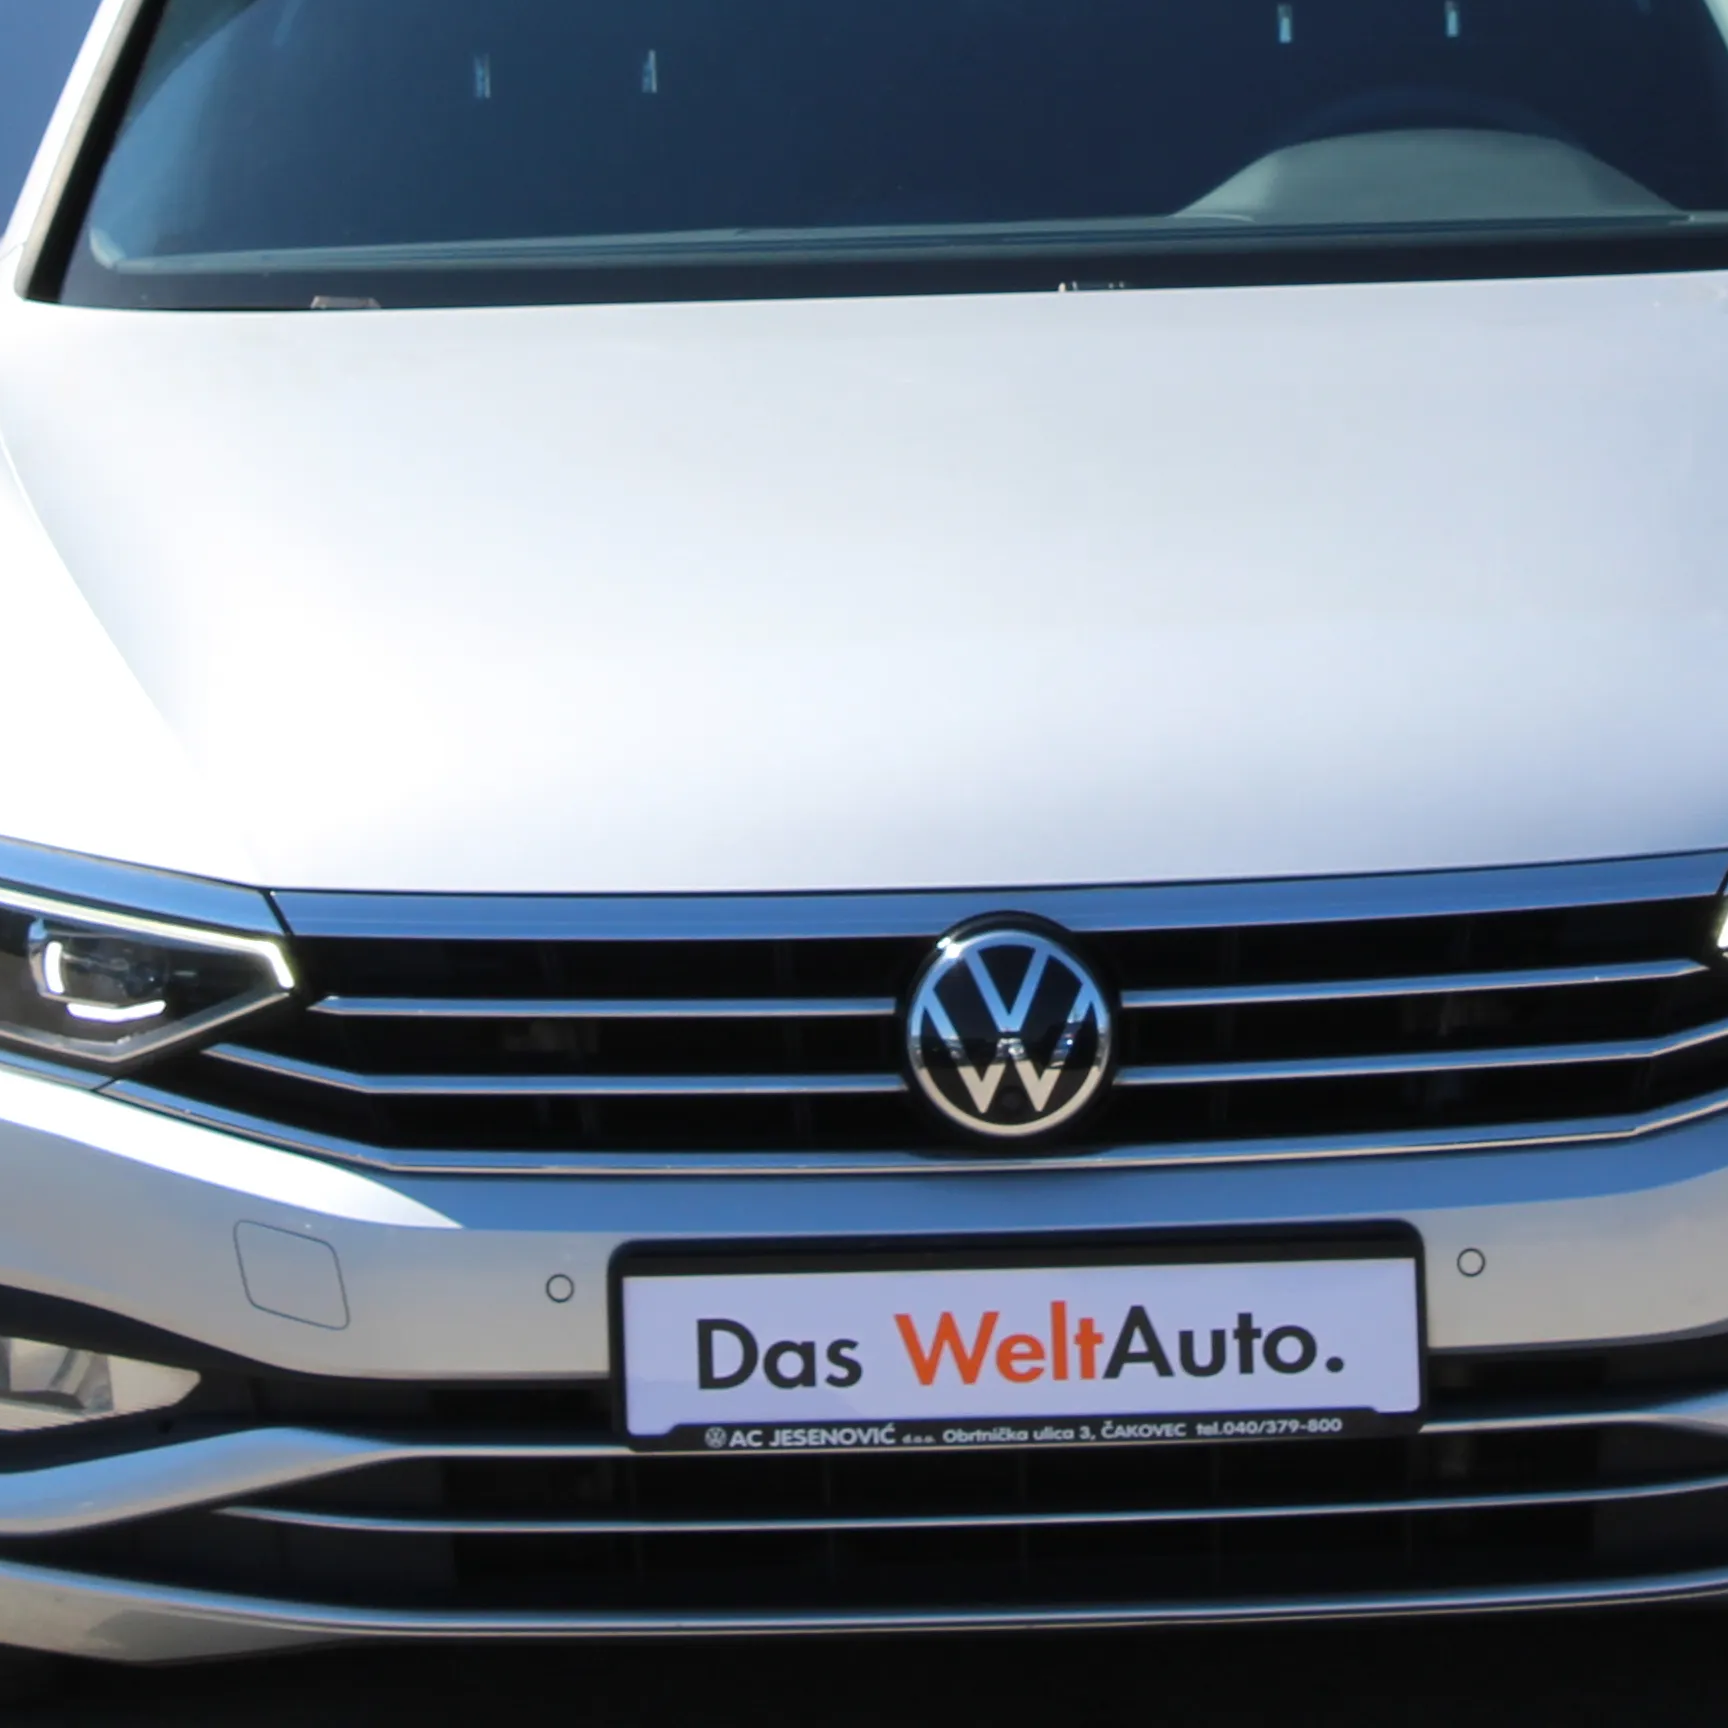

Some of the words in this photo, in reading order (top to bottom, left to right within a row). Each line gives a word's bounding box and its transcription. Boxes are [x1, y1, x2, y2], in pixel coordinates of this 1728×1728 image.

[697, 1319, 862, 1389] Das
[896, 1302, 1344, 1385] WeltAuto.
[729, 1429, 763, 1447] AC
[769, 1423, 896, 1446] JESENOVIĆ
[943, 1427, 1028, 1443] Obrtnička
[1033, 1426, 1074, 1440] ulica
[1080, 1426, 1096, 1440] 3,
[1101, 1420, 1186, 1439] ČAKOVEC
